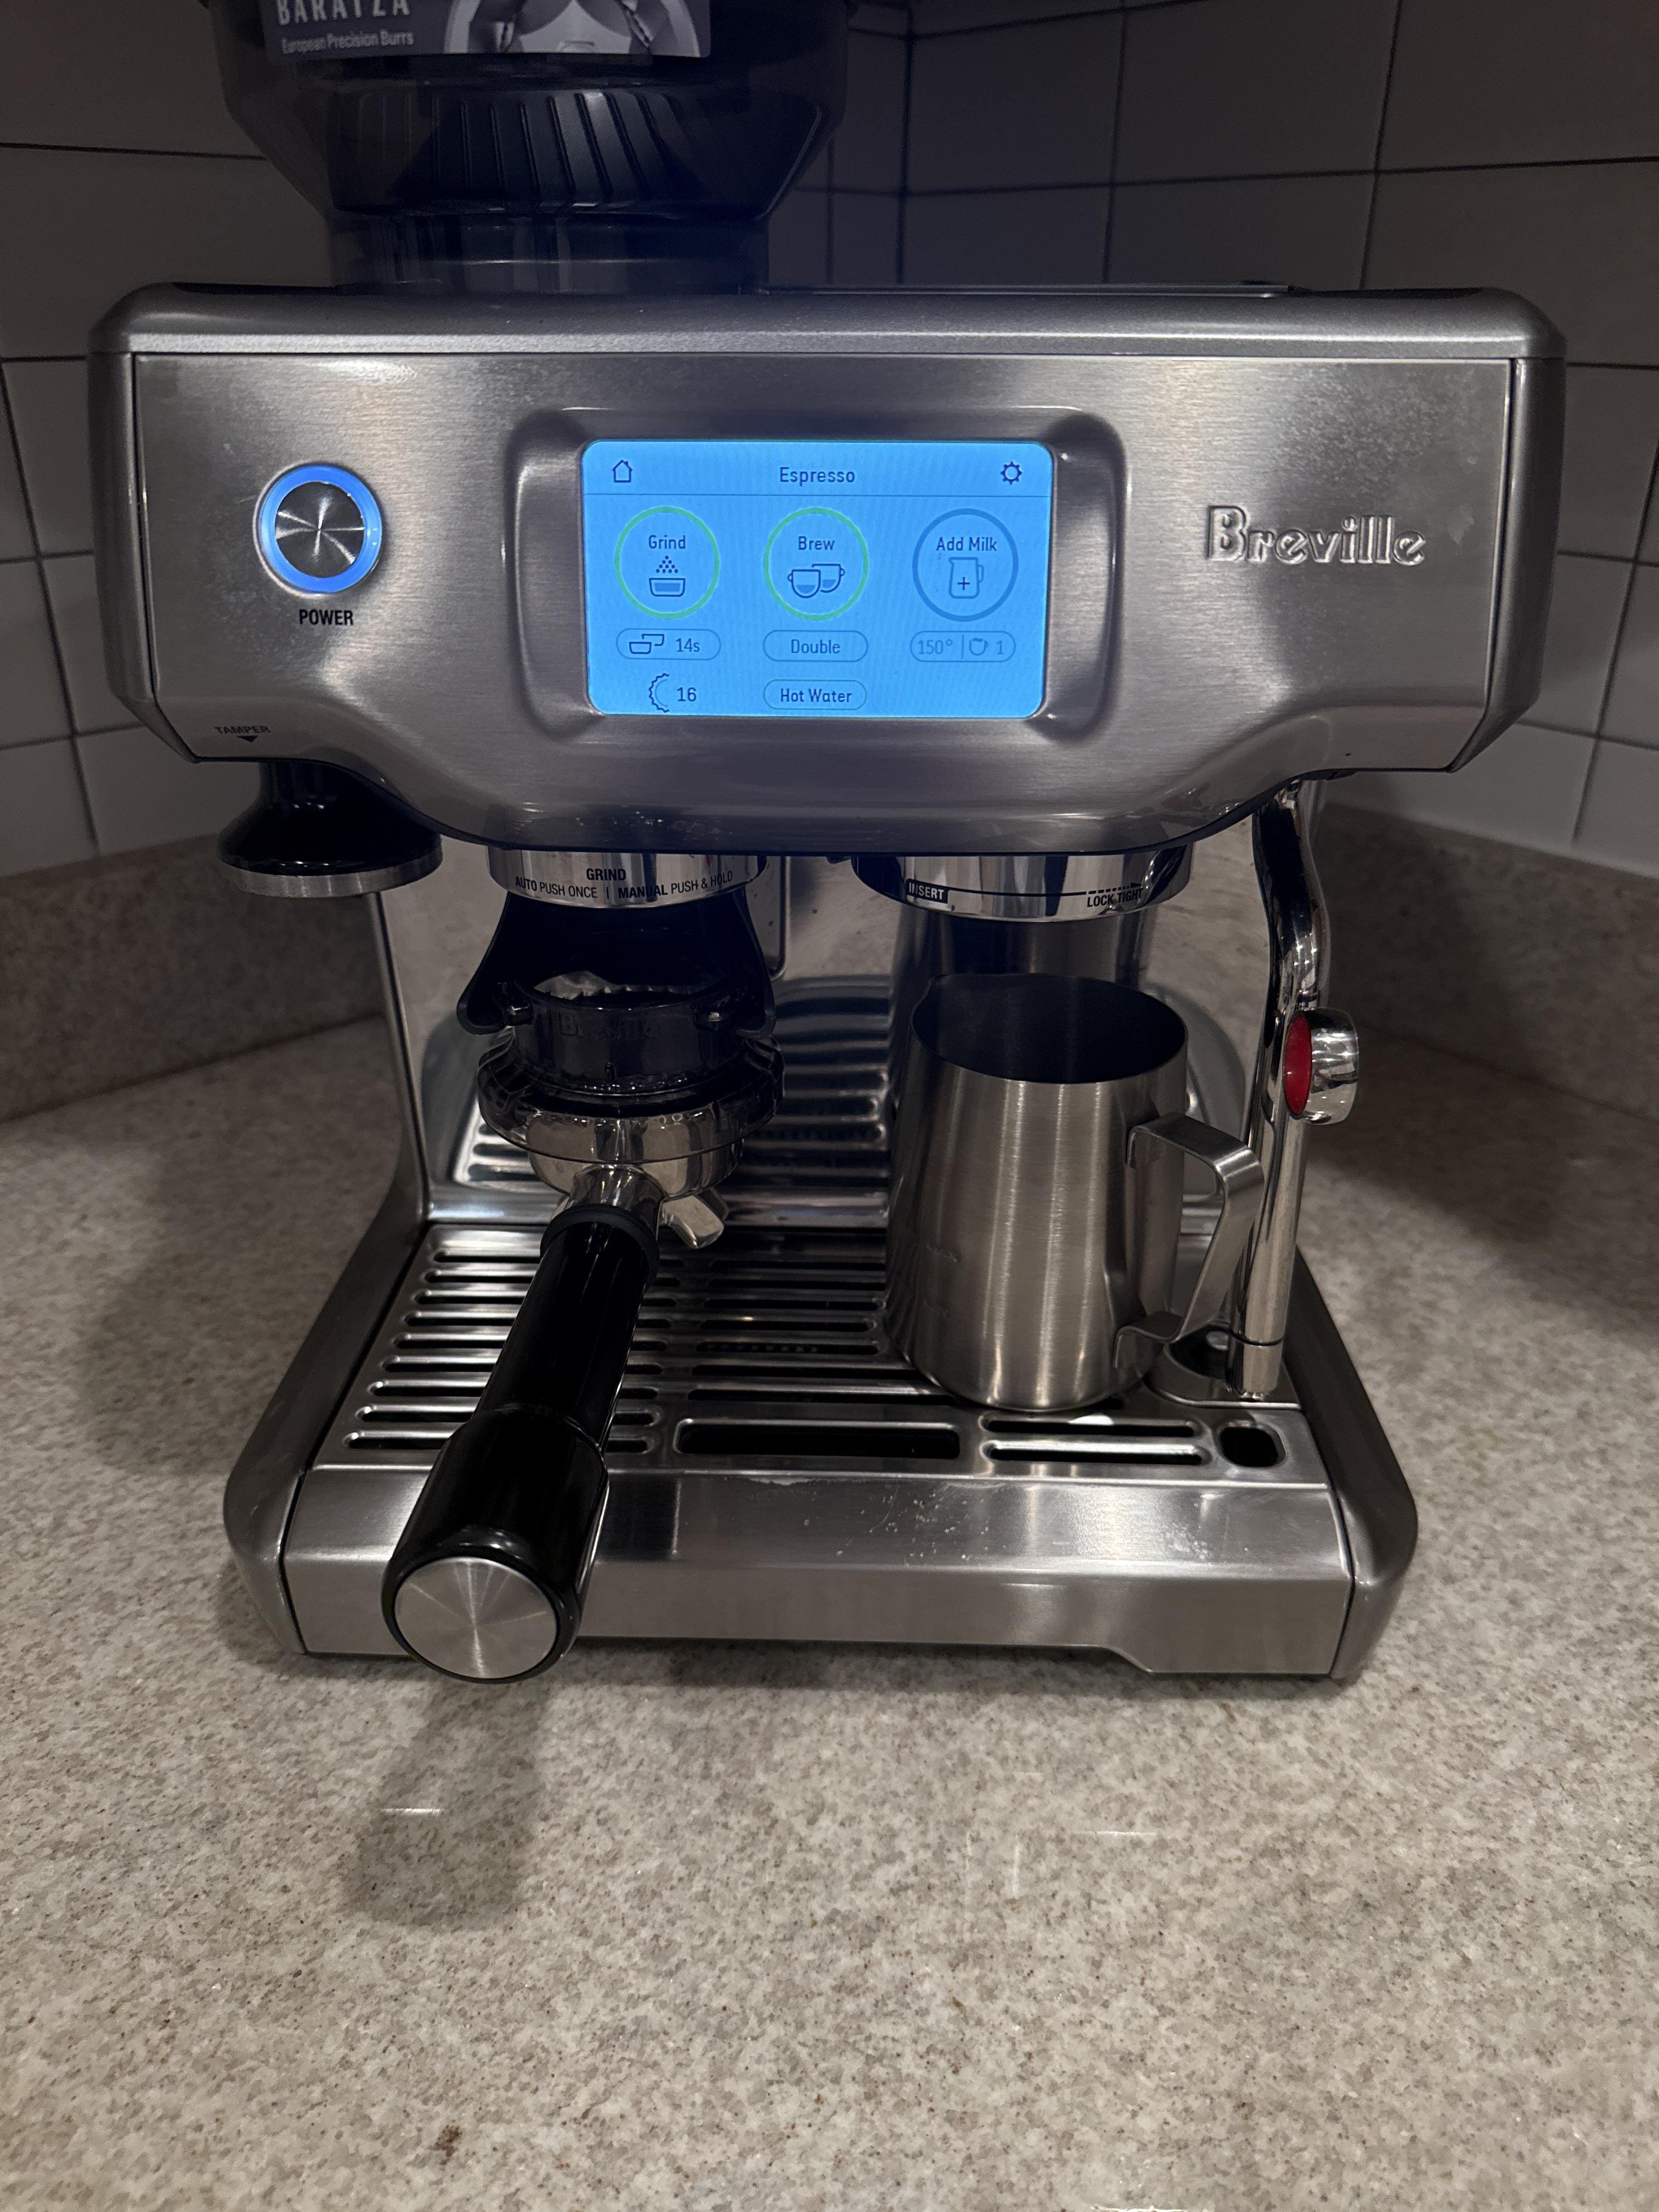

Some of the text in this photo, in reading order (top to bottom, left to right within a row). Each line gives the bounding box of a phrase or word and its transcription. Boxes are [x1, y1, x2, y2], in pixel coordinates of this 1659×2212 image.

[281, 29, 414, 54] European Precision Burrs
[780, 467, 855, 486] Espresso
[648, 535, 686, 550] Grind
[1207, 505, 1426, 566] Breville
[798, 536, 835, 551] Brew
[936, 537, 997, 551] Add Milk
[299, 609, 354, 625] POWER
[676, 638, 700, 653] 14s
[791, 639, 840, 654] Double
[996, 640, 1003, 654] 1
[677, 687, 697, 702] 16
[780, 689, 852, 703] Hot Water
[214, 725, 271, 735] TAMPER
[586, 868, 627, 881] GRIND
[515, 876, 597, 899] AUTO PUSH ONCE
[618, 871, 733, 899] MANUAL PUSH & HOLD
[909, 882, 944, 901] INSERT
[1087, 887, 1144, 908] LOCK TIGHT
